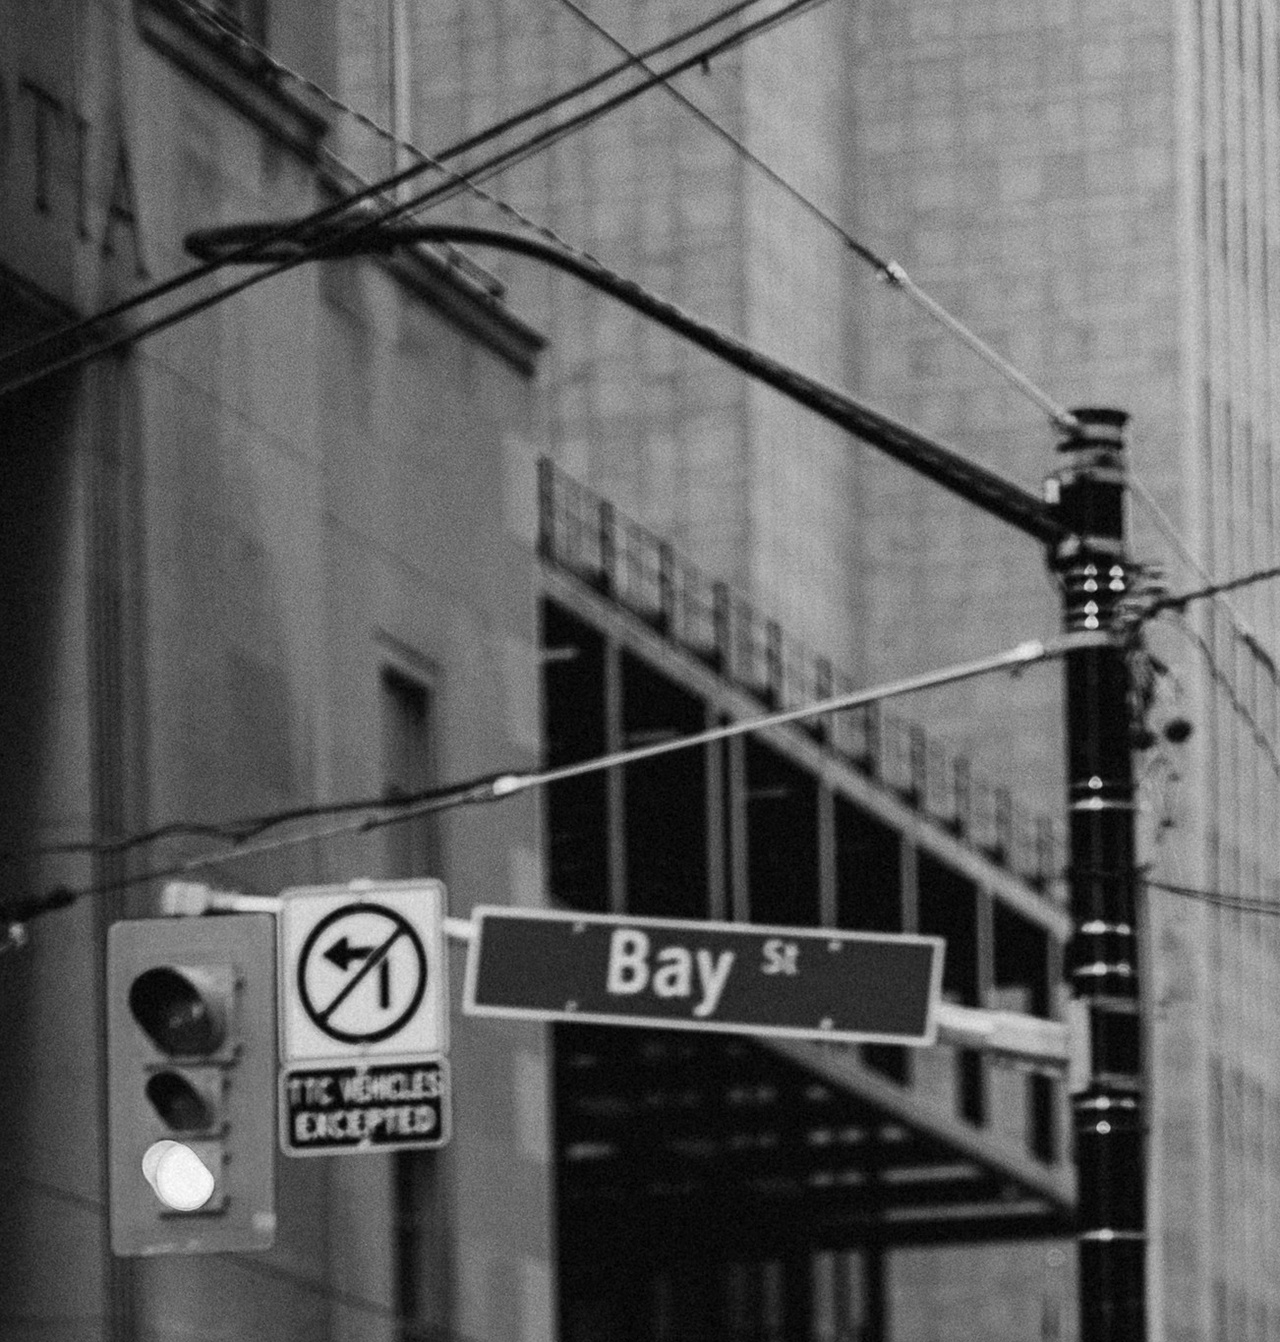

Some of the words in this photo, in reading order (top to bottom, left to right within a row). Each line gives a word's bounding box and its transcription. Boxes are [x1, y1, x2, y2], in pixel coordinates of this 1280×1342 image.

[606, 928, 735, 1017] Bay
[761, 938, 799, 975] St
[288, 1076, 333, 1105] TTC
[338, 1069, 443, 1102] VEHICLES
[295, 1104, 437, 1141] EXCEPTED
